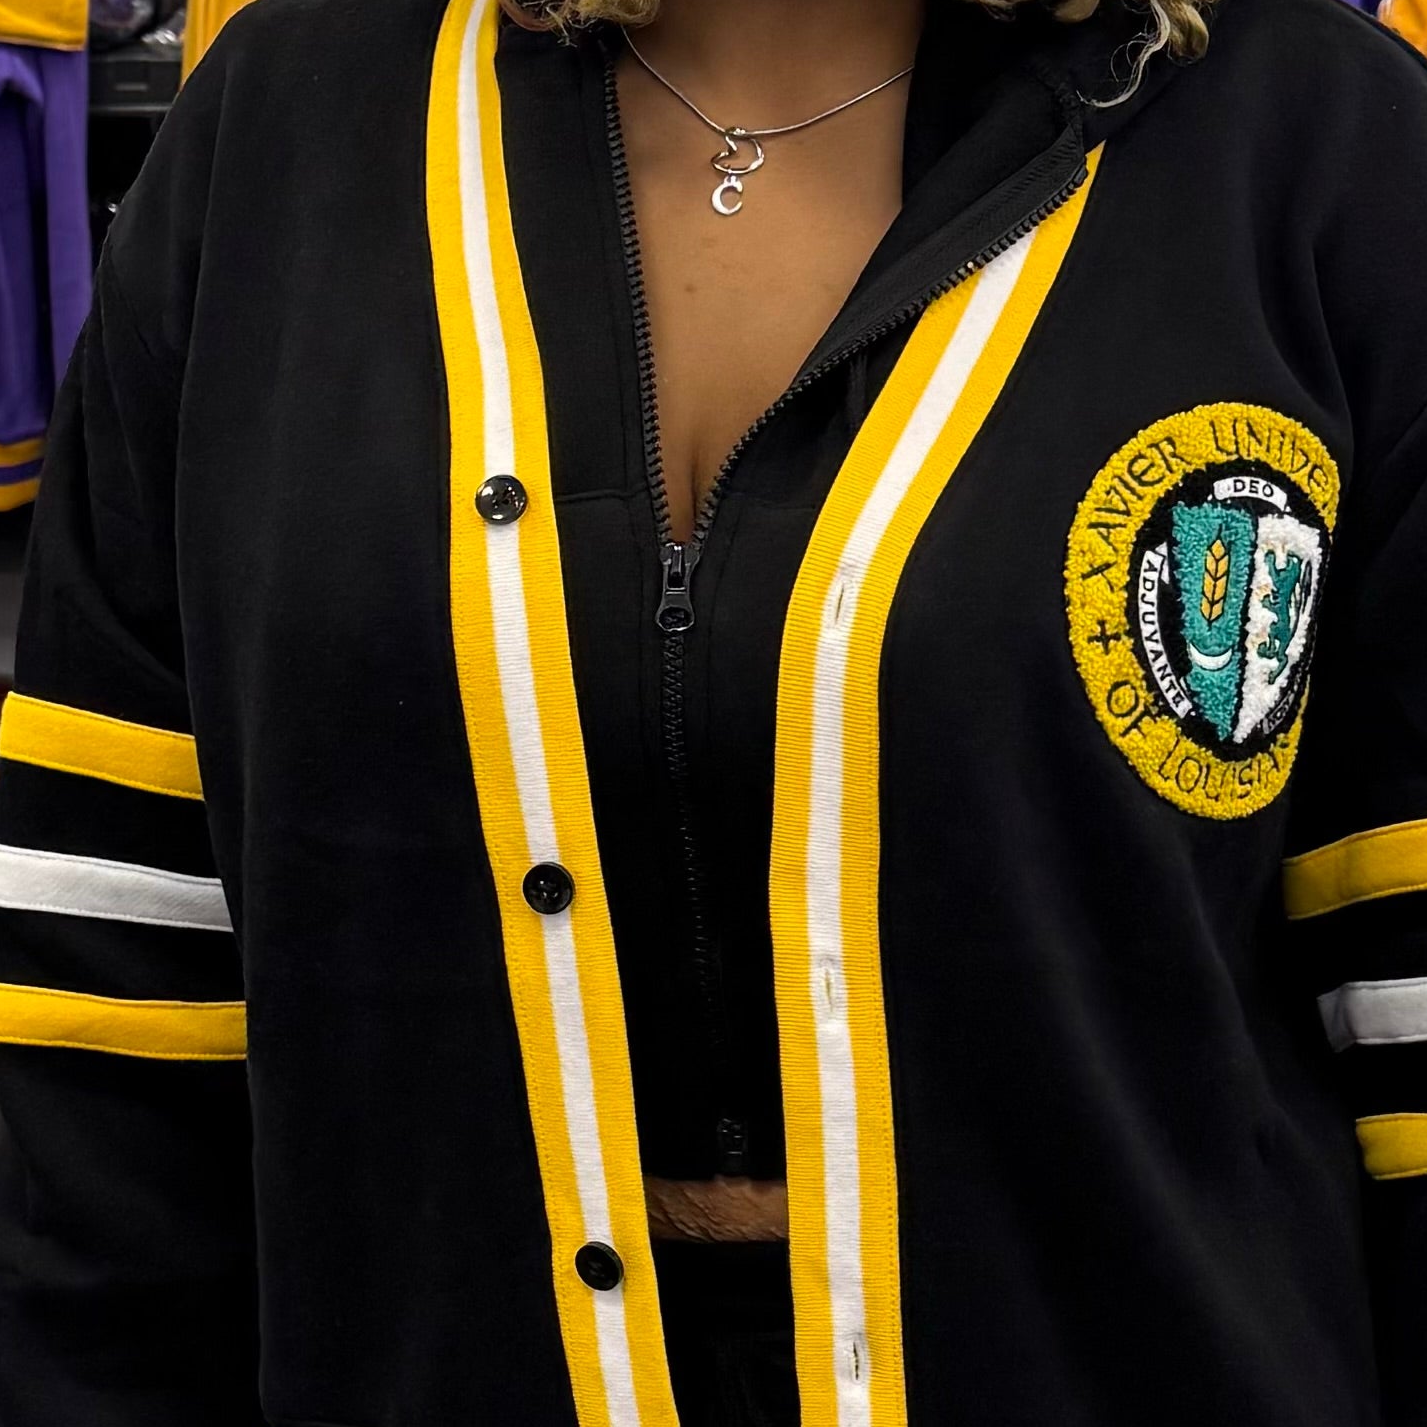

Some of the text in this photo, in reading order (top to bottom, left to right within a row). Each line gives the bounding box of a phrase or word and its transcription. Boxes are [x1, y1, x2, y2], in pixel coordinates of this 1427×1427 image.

[1079, 417, 1330, 594] XAVIER UNIVE
[1233, 479, 1273, 498] DEO
[1106, 679, 1159, 740] OF
